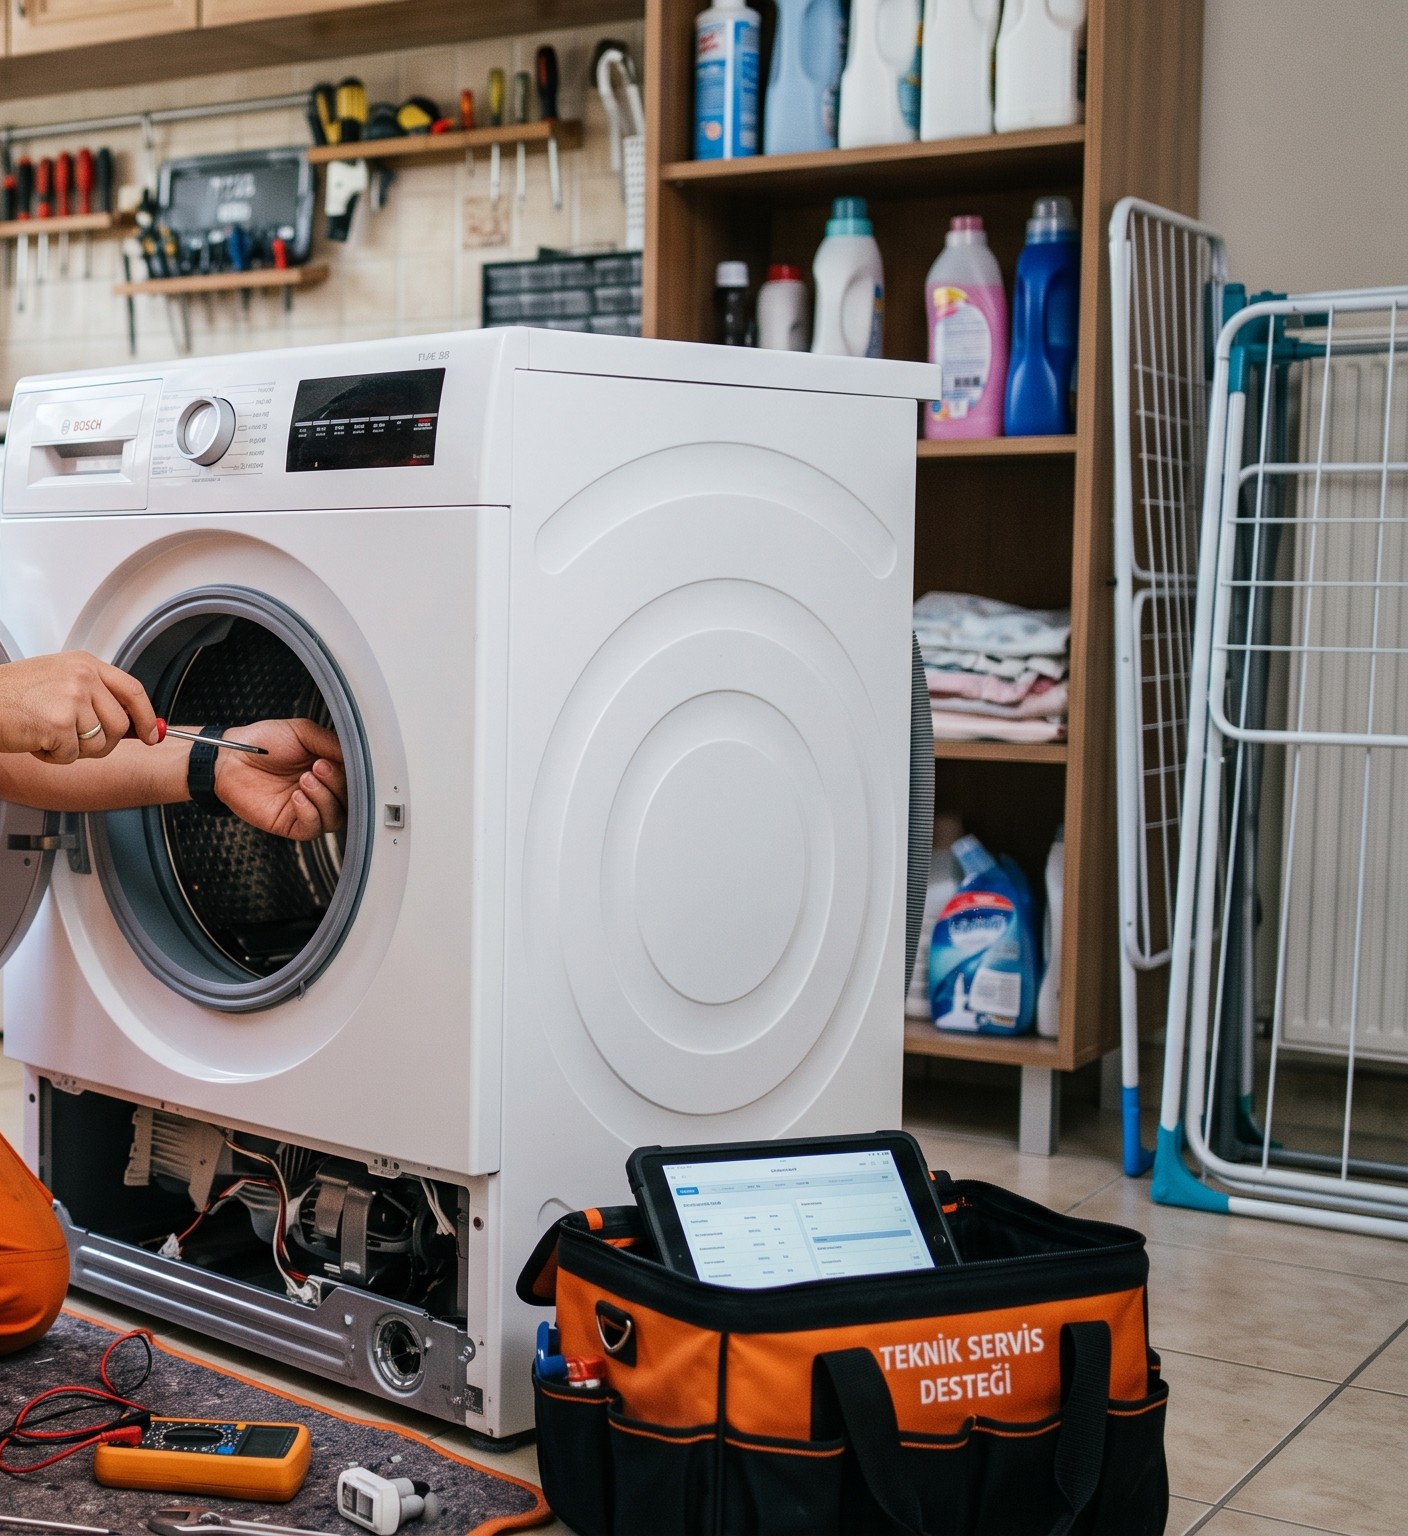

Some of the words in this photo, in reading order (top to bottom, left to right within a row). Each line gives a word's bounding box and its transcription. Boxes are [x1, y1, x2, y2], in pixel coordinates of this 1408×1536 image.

[73, 419, 102, 431] BOSCH
[879, 1333, 963, 1371] TEKNİK
[967, 1323, 1045, 1361] SERVİS
[920, 1363, 1012, 1405] DESTEĞİ
